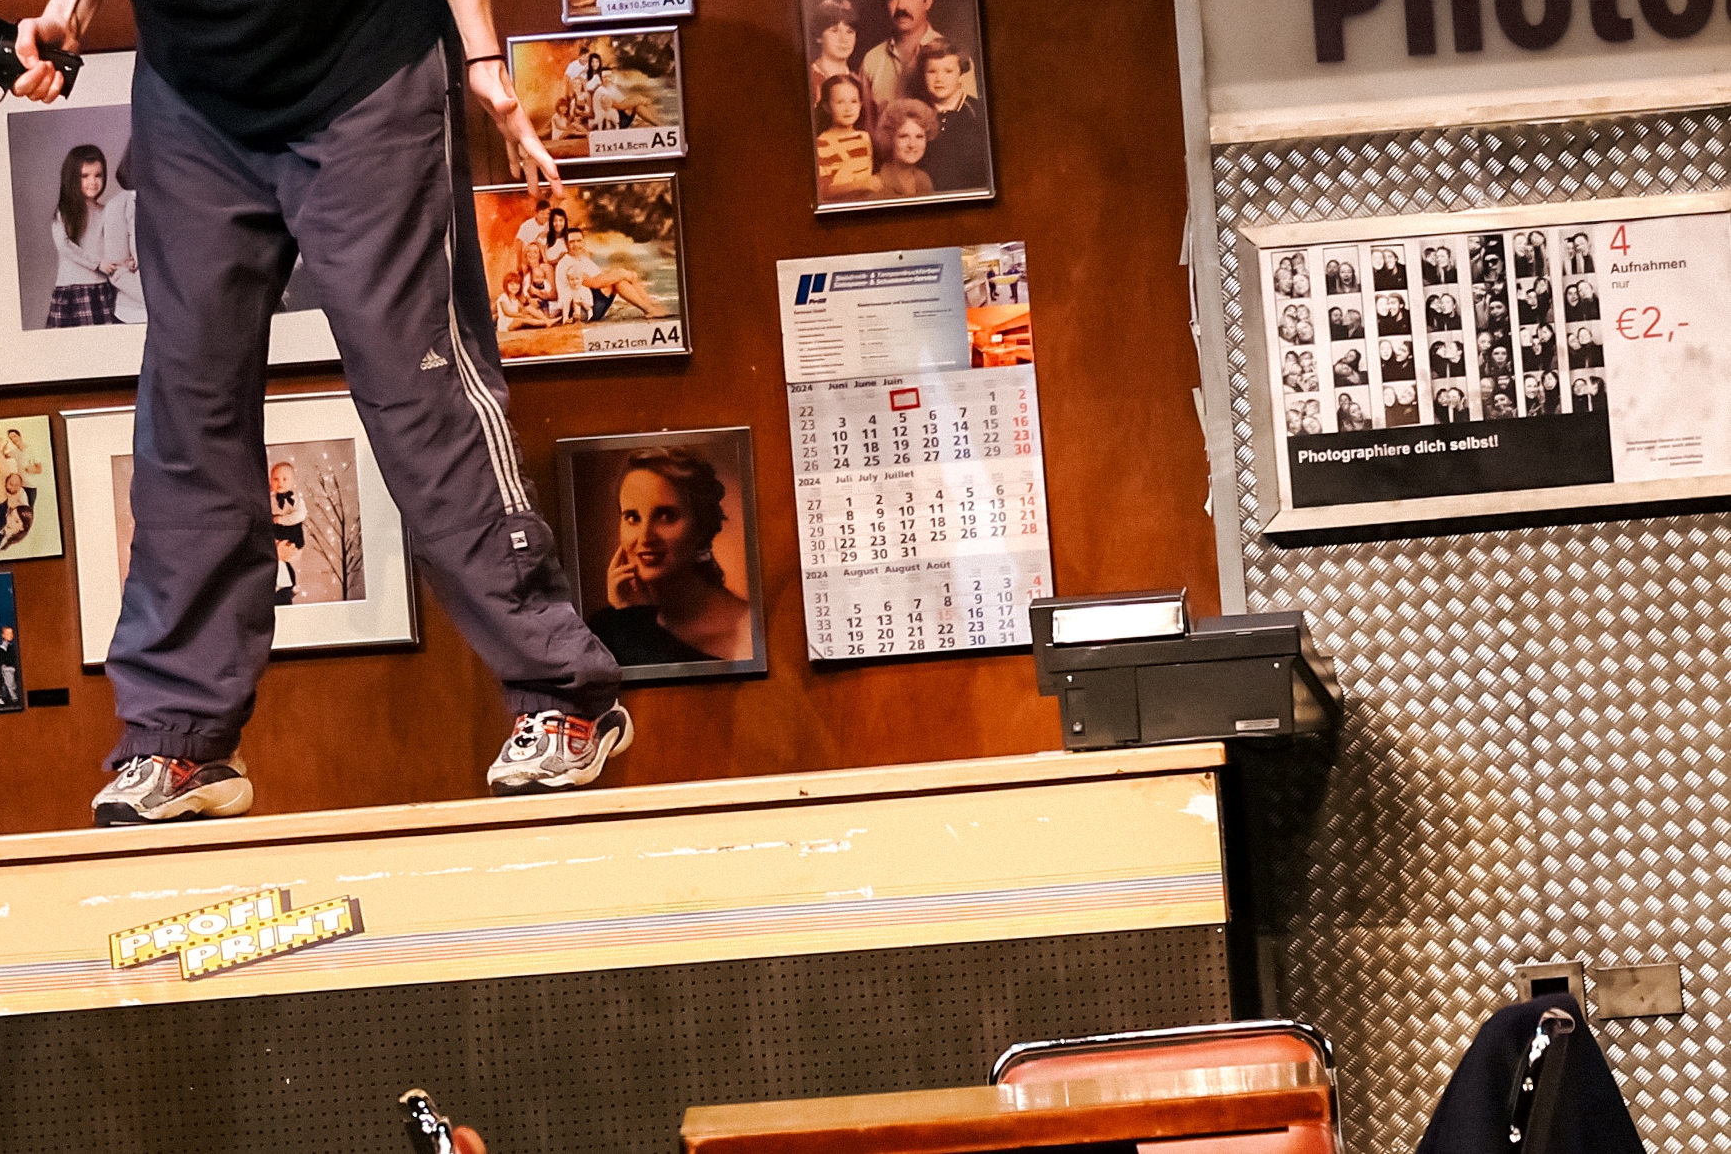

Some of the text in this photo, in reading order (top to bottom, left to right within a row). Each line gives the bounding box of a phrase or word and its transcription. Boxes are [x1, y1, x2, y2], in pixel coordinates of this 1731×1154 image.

[651, 131, 677, 148] A5
[1609, 225, 1631, 256] 4
[1610, 259, 1687, 274] Aufnahmen
[1611, 280, 1630, 289] nur
[651, 326, 680, 345] A4
[1616, 306, 1689, 342] €2,-
[789, 377, 903, 394] 2024 Juni June Juin
[799, 388, 1026, 418] 22 1 2
[800, 402, 1028, 431] 23 3 4 5 6 7 8 9
[801, 415, 1029, 445] 24 10 11 12 13 14 15 16
[802, 429, 1030, 458] 25 17 18 19 20 21 22 23
[803, 443, 1031, 472] 26 24 25 26 27 28 29 30
[1298, 434, 1499, 463] Photographiere dich selbst!
[798, 470, 914, 487] 2024 Juli July Juillet
[807, 482, 1034, 511] 27 1 2 3 4 5 6 7
[808, 496, 1036, 525] 28 8 9 10 11 12 13 14
[809, 509, 1036, 538] 29 15 16 17 18 19 20 21
[810, 522, 1038, 552] 30 22 23 24 25 26 27 28
[811, 546, 917, 565] 31 29 30 31
[805, 561, 950, 580] 2024 August August Août
[815, 575, 1042, 604] 31 1 2 3 4
[815, 605, 830, 618] 32
[853, 603, 862, 615] 5
[883, 600, 892, 612] 6
[913, 598, 922, 609] 7
[944, 596, 952, 607] 8
[974, 593, 983, 605] 9
[997, 591, 1013, 603] 10
[816, 604, 1013, 631] 33 12 13 14 15 16 17
[817, 618, 1015, 644] 34 19 20 21 22 23 24
[848, 644, 865, 655] 26
[878, 641, 895, 653] 27
[908, 639, 925, 651] 28
[938, 636, 955, 648] 29
[969, 634, 986, 646] 30
[999, 632, 1015, 644] 31
[119, 896, 275, 960] PROFI
[185, 906, 346, 971] PRINT
